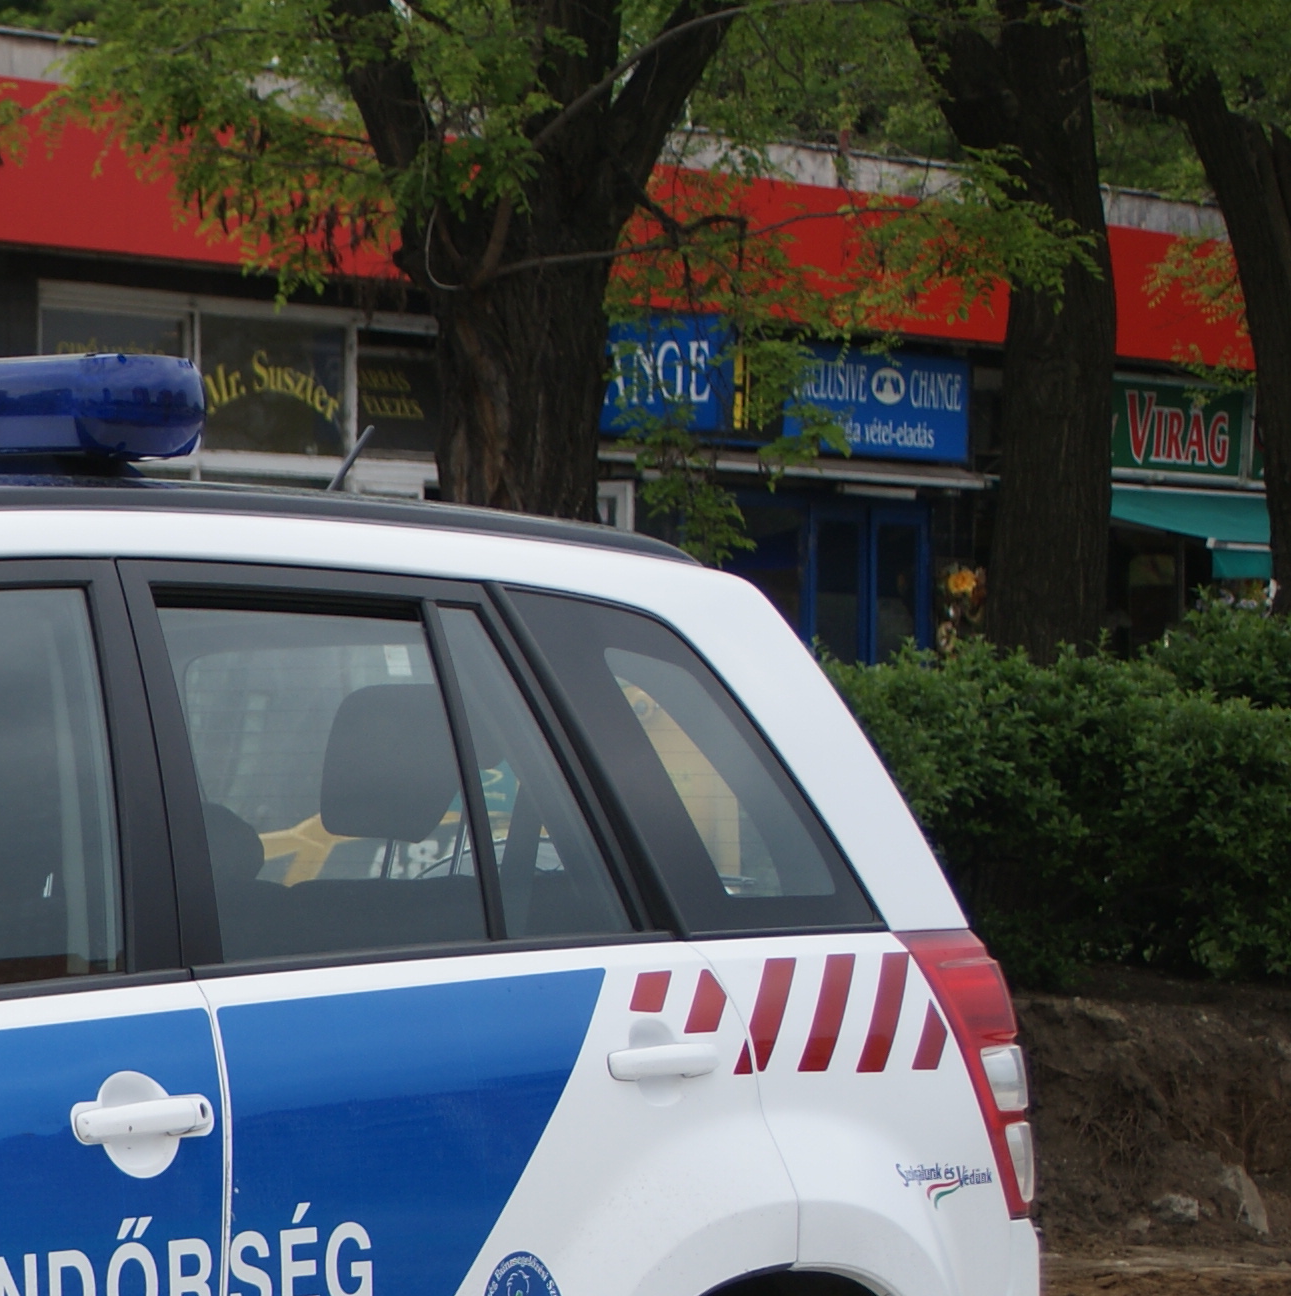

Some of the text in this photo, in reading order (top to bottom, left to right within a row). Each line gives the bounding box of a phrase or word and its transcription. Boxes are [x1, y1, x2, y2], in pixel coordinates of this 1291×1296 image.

[204, 349, 340, 422] Mr. Suszter
[909, 369, 962, 413] CHANGE
[1125, 389, 1230, 469] VIRÁG
[944, 1163, 955, 1180] és
